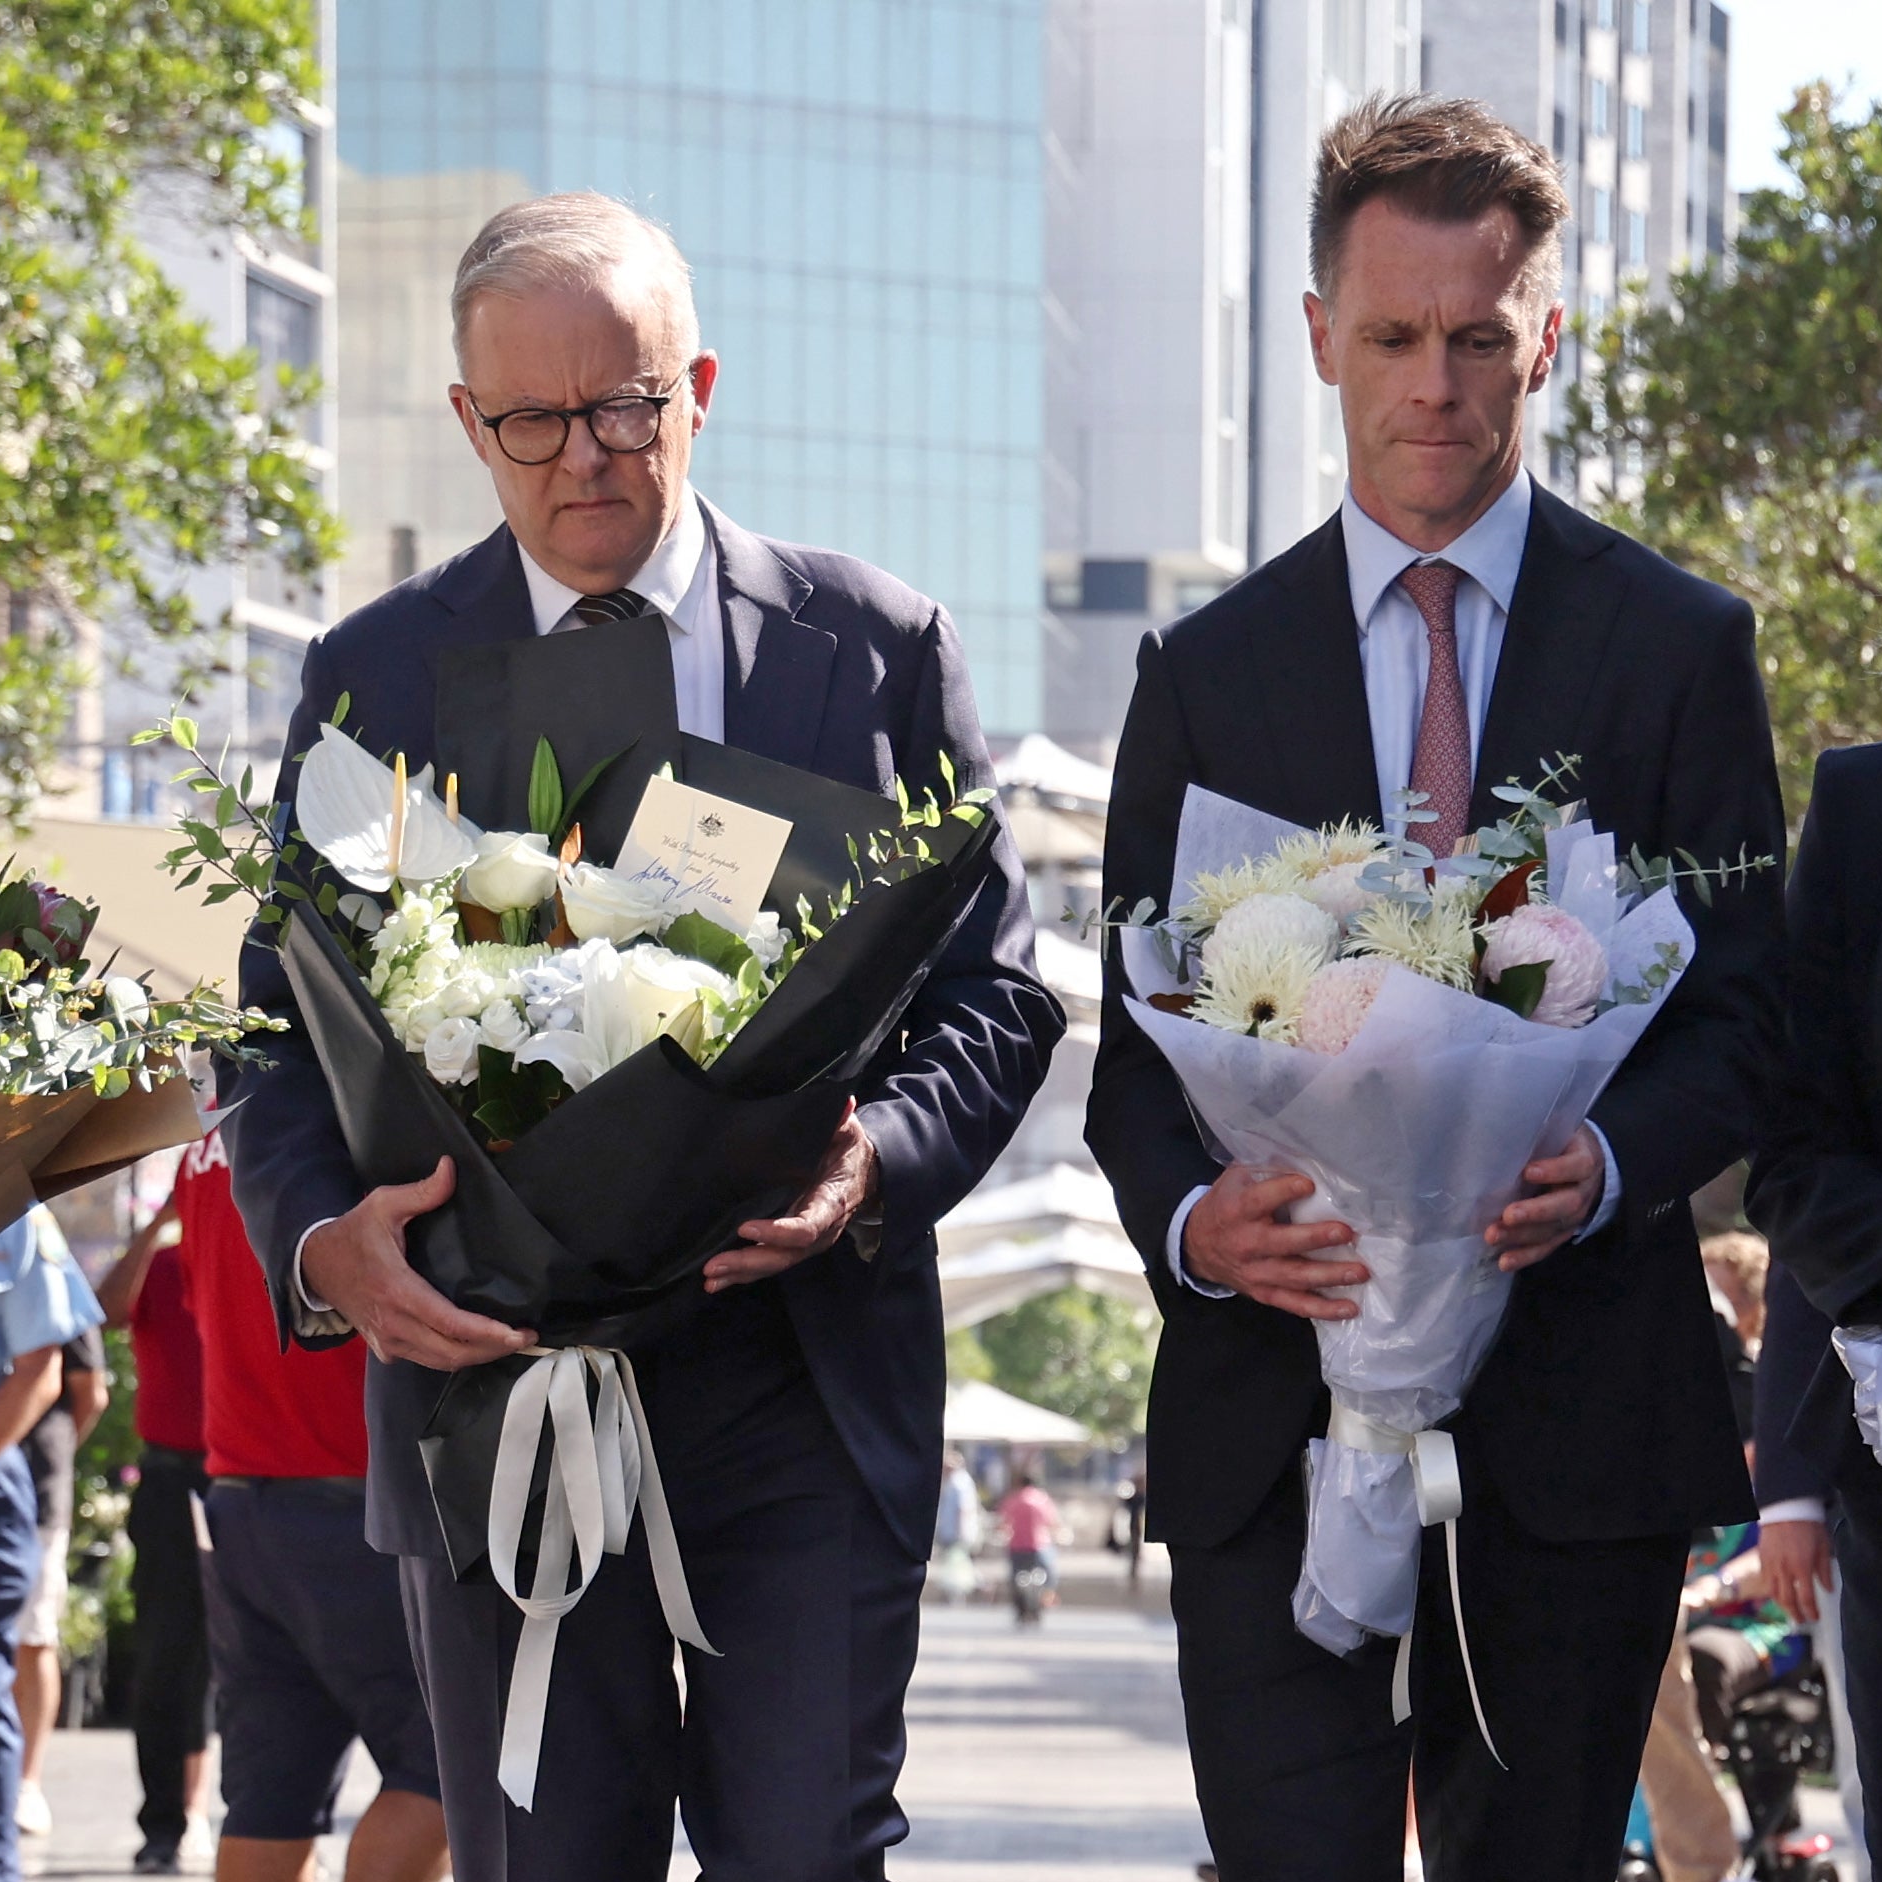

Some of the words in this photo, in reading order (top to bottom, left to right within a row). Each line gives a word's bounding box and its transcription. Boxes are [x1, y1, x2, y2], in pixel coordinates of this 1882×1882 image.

[661, 835, 678, 849] With
[705, 853, 740, 873] Sympathy
[683, 862, 703, 874] from
[185, 1129, 228, 1181] RA
